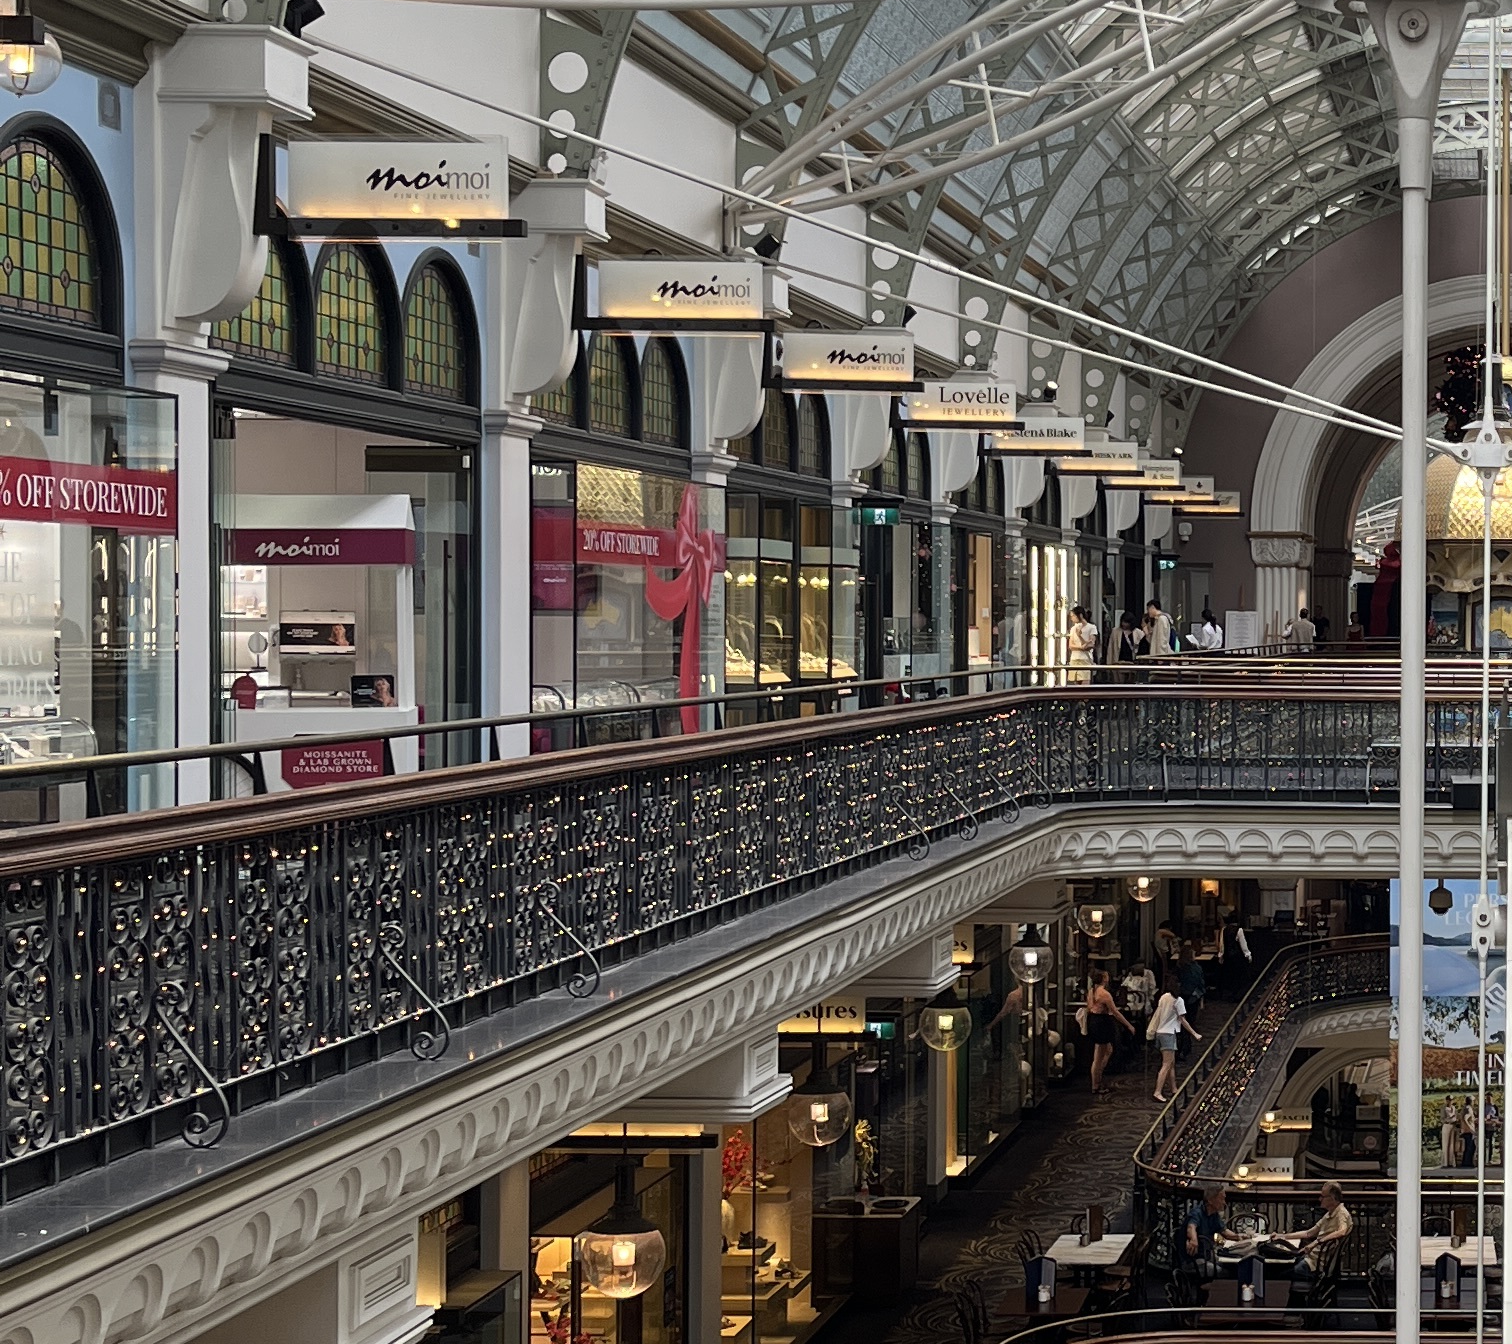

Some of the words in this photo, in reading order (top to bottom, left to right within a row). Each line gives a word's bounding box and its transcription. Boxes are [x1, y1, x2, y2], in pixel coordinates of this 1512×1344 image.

[942, 407, 1007, 416] JEWELLERY
[17, 473, 56, 508] OFF
[60, 477, 168, 518] STOREWIDE
[583, 528, 600, 551] 20%
[600, 531, 616, 553] OFF
[616, 533, 660, 557] STOREWIDE
[303, 750, 367, 758] MOISSANITE
[346, 765, 379, 773] STORE
